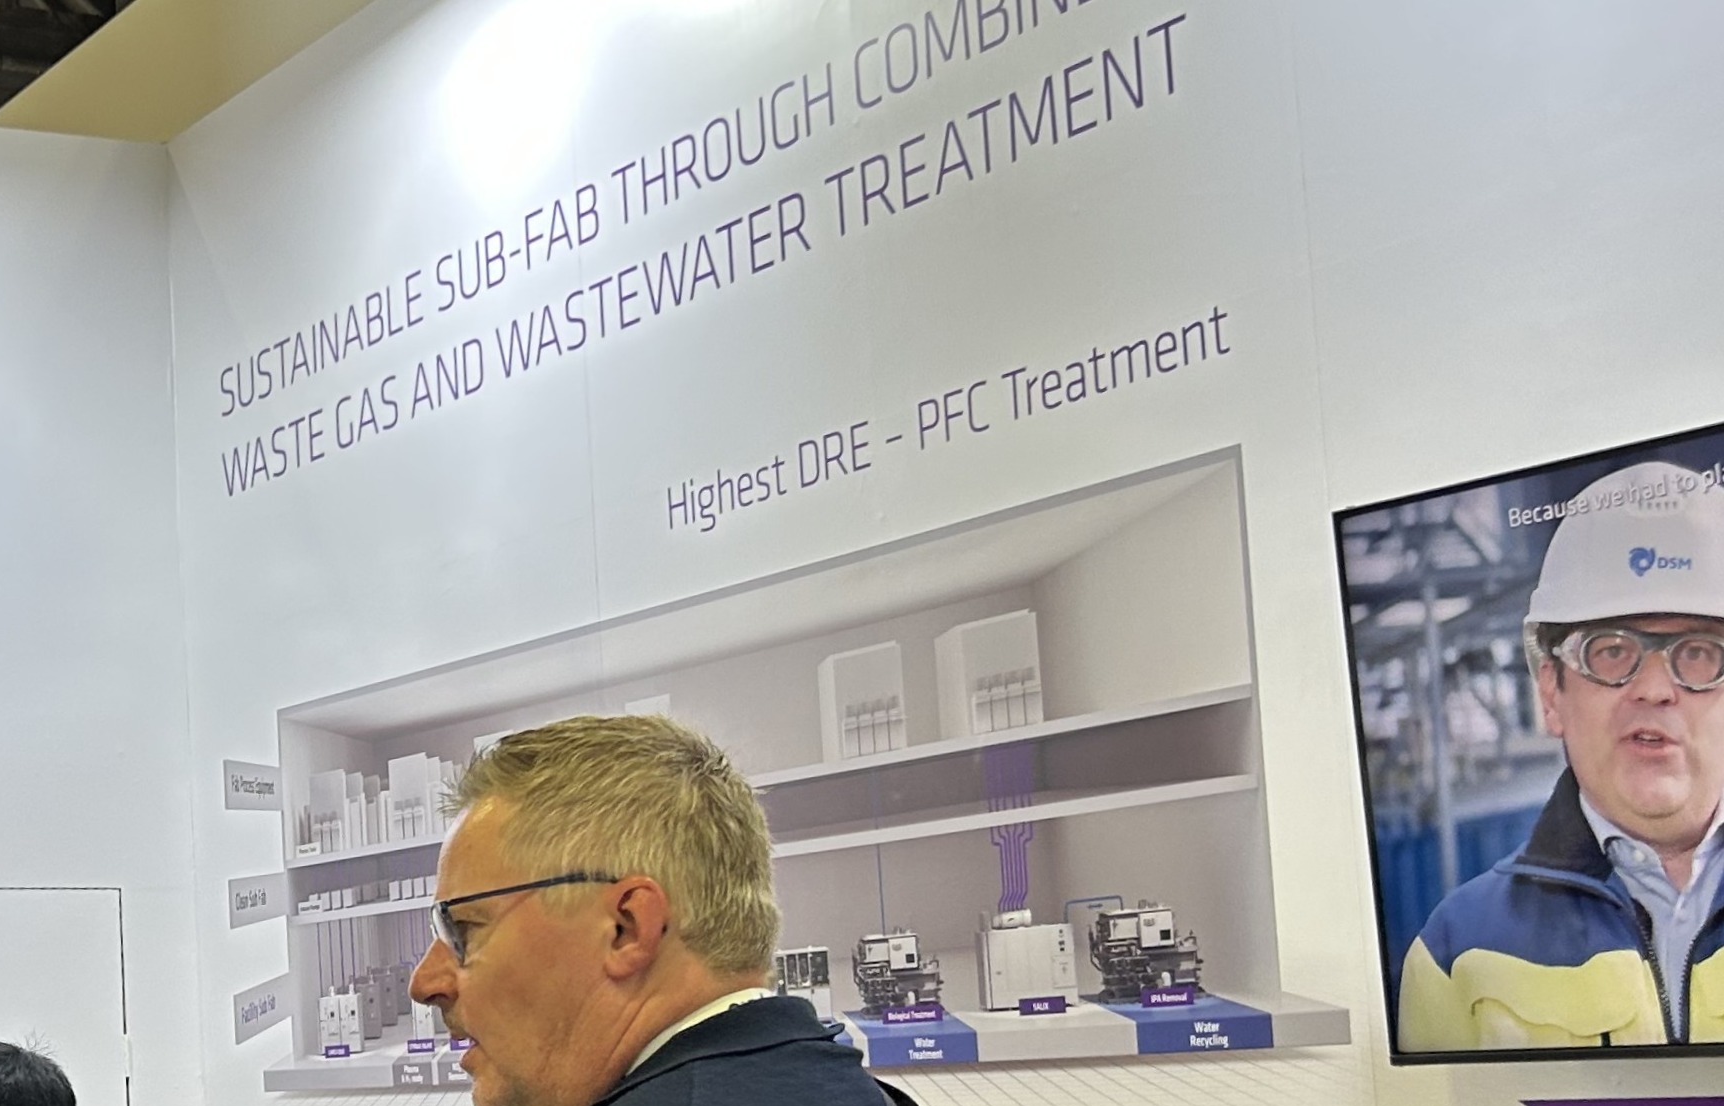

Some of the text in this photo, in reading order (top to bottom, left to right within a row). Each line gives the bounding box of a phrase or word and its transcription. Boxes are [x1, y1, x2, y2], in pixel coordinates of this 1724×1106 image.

[220, 270, 424, 417] SUSTAINABLE
[435, 183, 600, 312] SUB-FAB
[611, 62, 835, 225] THROUGH
[221, 13, 1187, 498] WASTE GAS AND WASTEWATER TREATMENT
[666, 455, 789, 533] Highest
[797, 420, 872, 489] DRE
[916, 380, 990, 450] PFC
[1000, 305, 1231, 421] Treatment
[1507, 497, 1589, 529] Because
[1594, 490, 1623, 511] we
[1627, 474, 1667, 504] had
[1671, 477, 1696, 494] to
[1657, 557, 1692, 570] DSM
[1193, 1021, 1220, 1034] Water
[913, 1037, 936, 1048] Water
[1190, 1033, 1229, 1048] Recycling
[908, 1049, 944, 1061] Treatment
